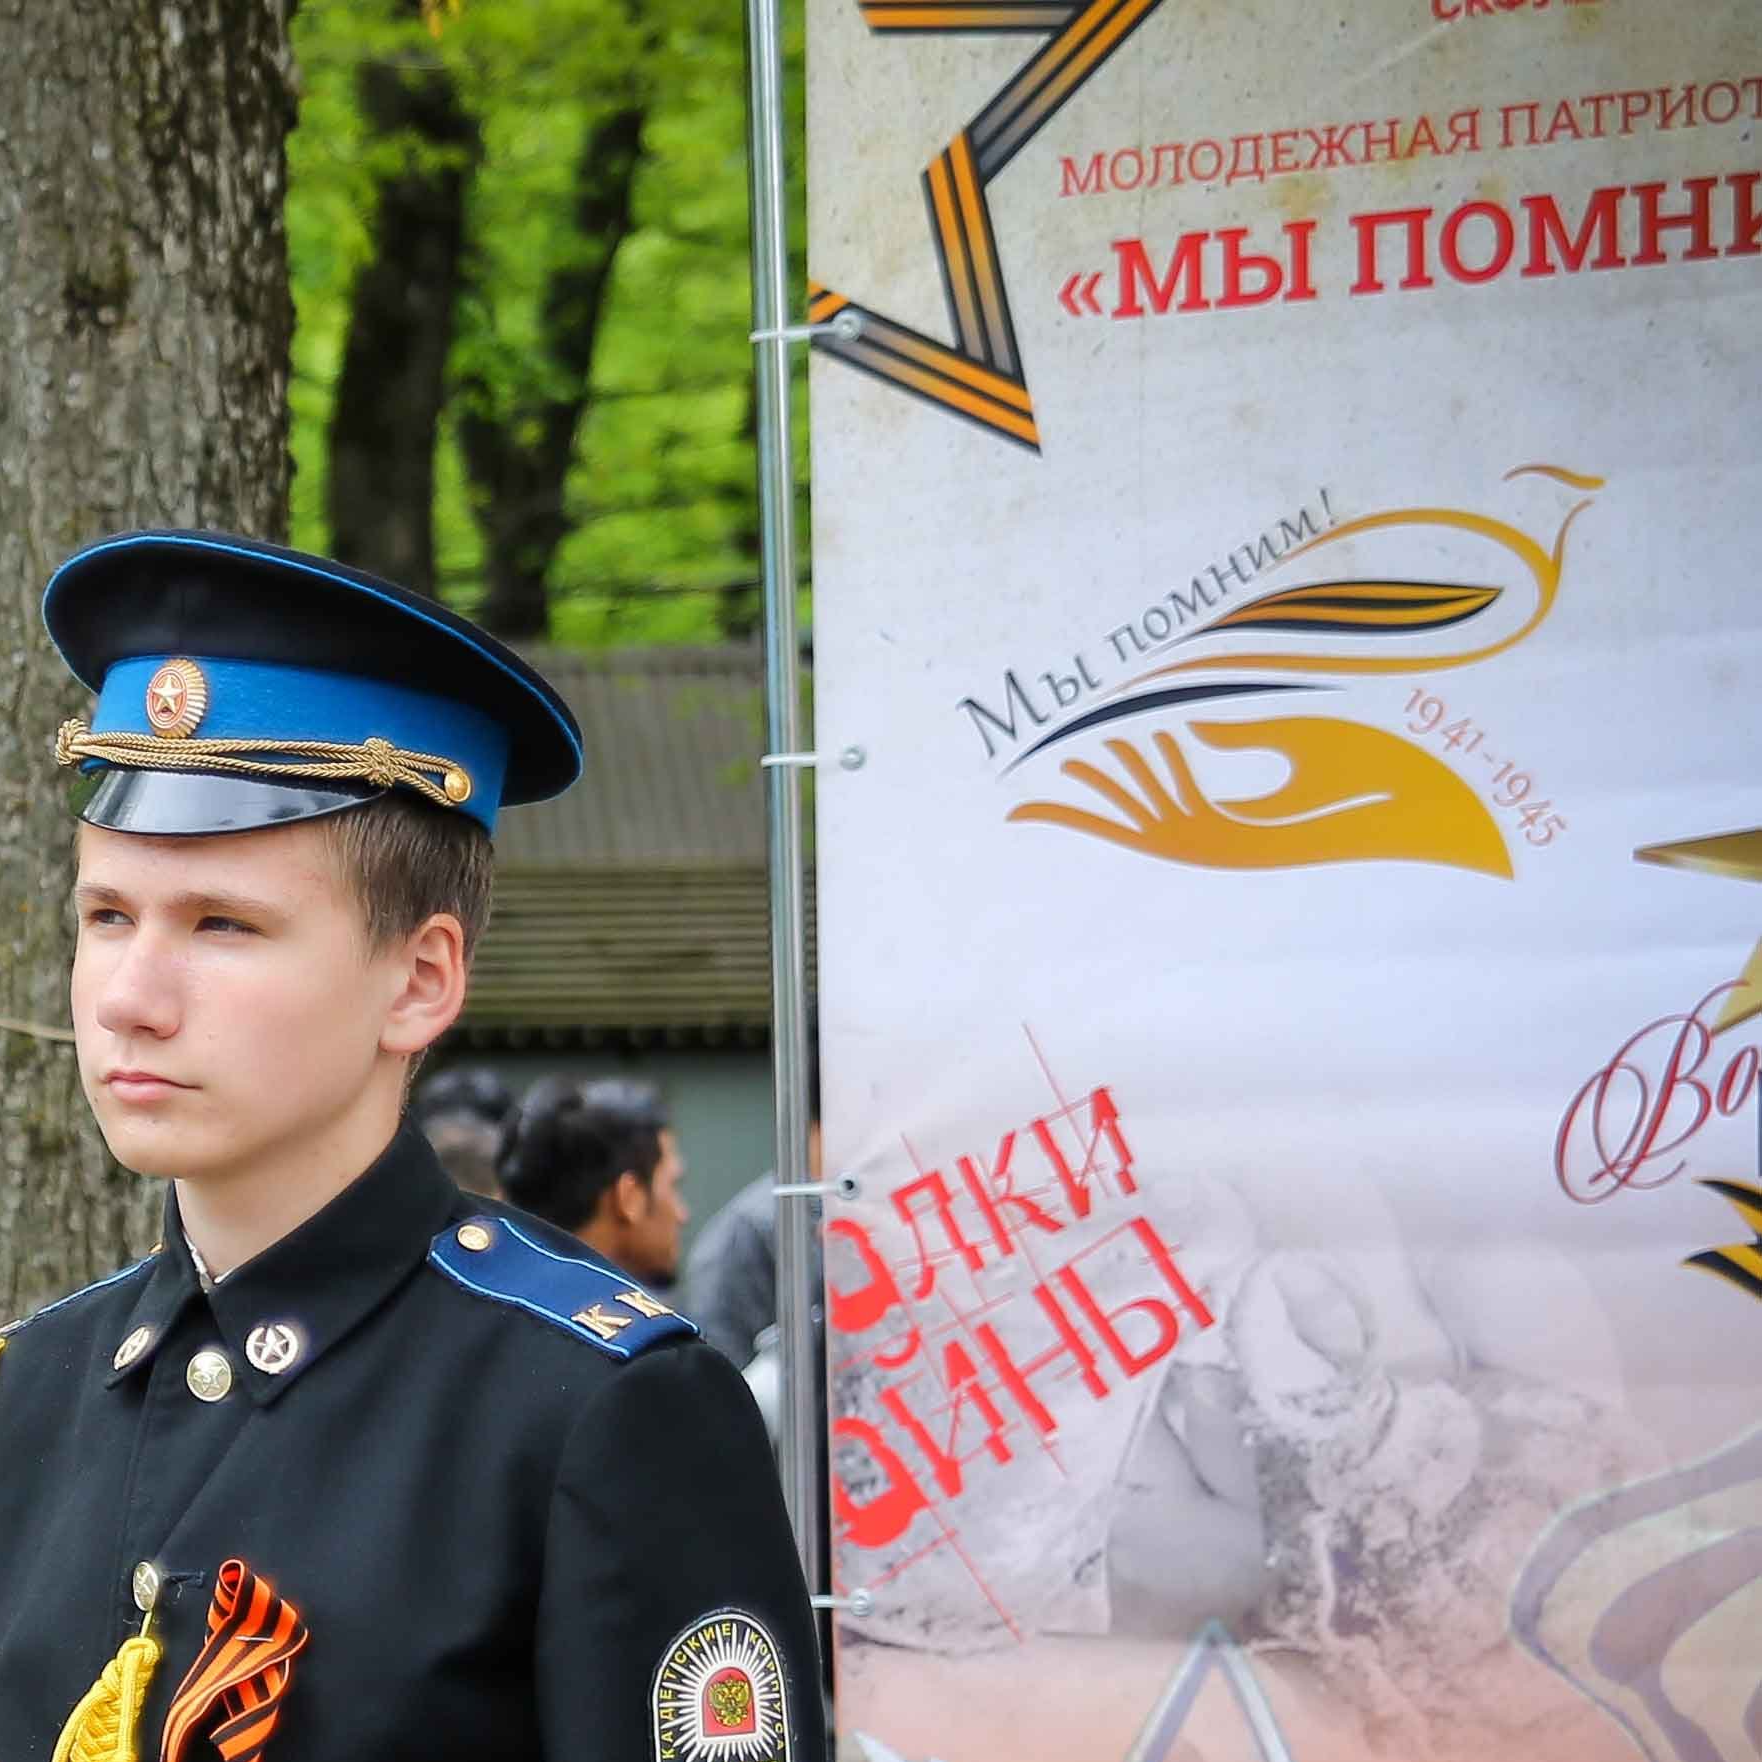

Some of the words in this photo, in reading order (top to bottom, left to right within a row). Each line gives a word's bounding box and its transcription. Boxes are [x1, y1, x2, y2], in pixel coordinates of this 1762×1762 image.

[1058, 107, 1481, 198] МОЛОДЕЖНАЯ
[1057, 219, 1318, 320] «МЫ
[957, 658, 1102, 759] Мы
[1104, 488, 1336, 664] помним!
[1402, 687, 1567, 847] 1941-1945
[659, 1622, 733, 1760] КАДЕТСКИЕ
[748, 1631, 785, 1750] КОРПУСА
